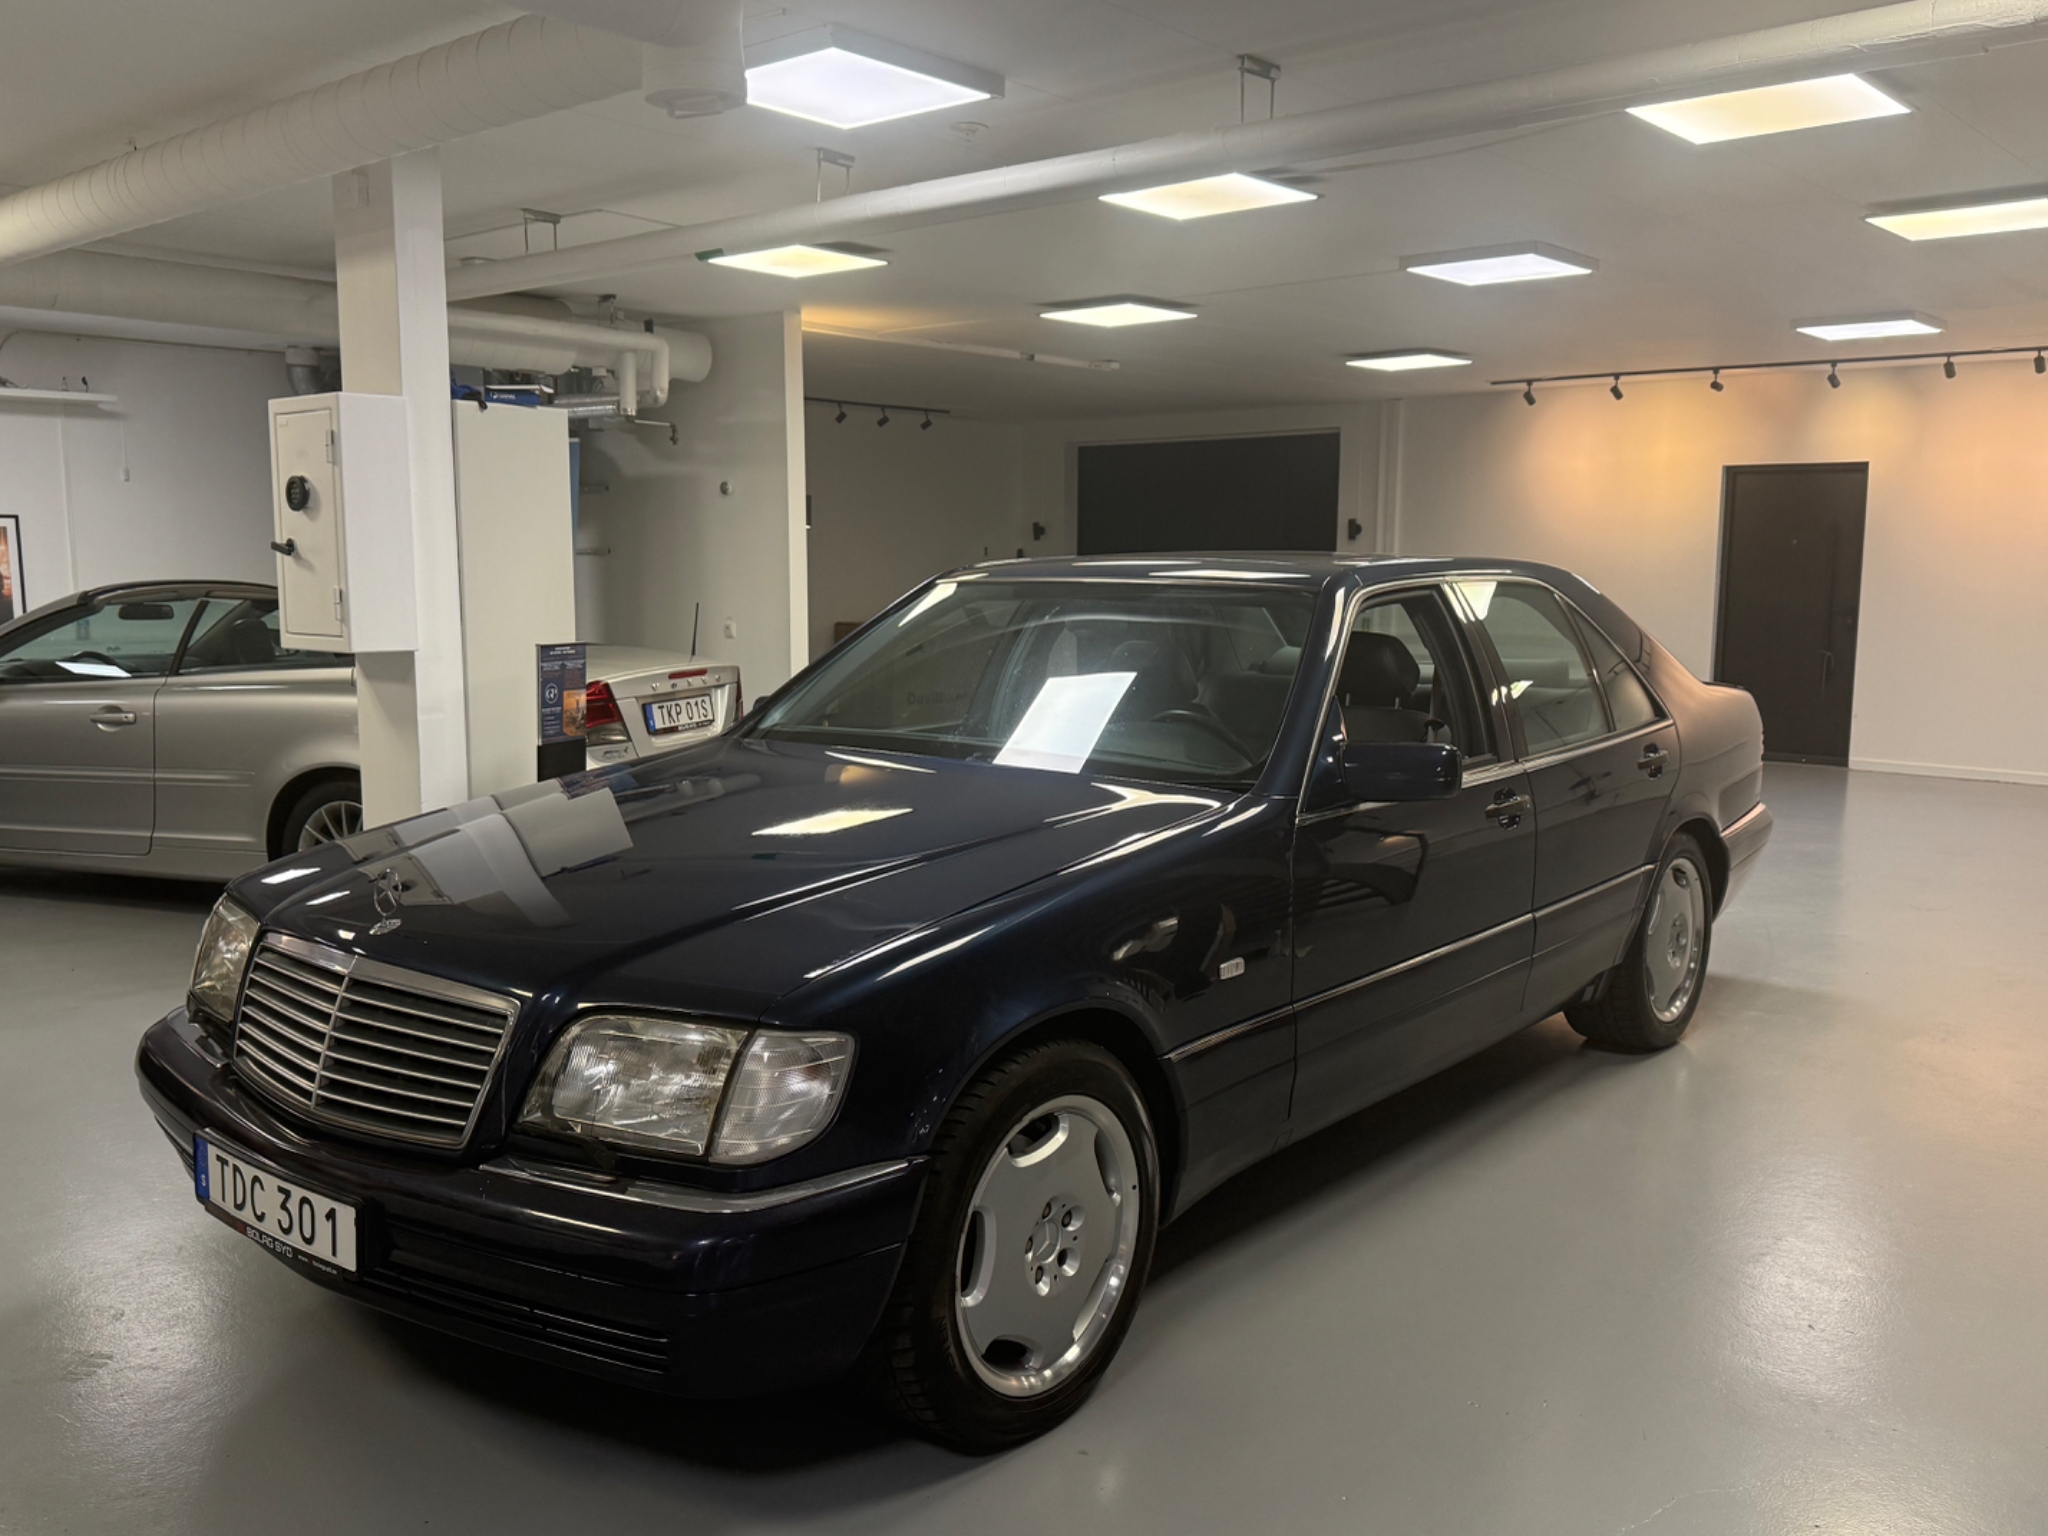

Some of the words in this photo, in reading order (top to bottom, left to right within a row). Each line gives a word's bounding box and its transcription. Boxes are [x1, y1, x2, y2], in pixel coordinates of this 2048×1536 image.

[658, 702, 682, 726] TKP
[686, 699, 709, 722] 01S
[215, 1154, 267, 1224] TDC
[277, 1185, 338, 1258] 301
